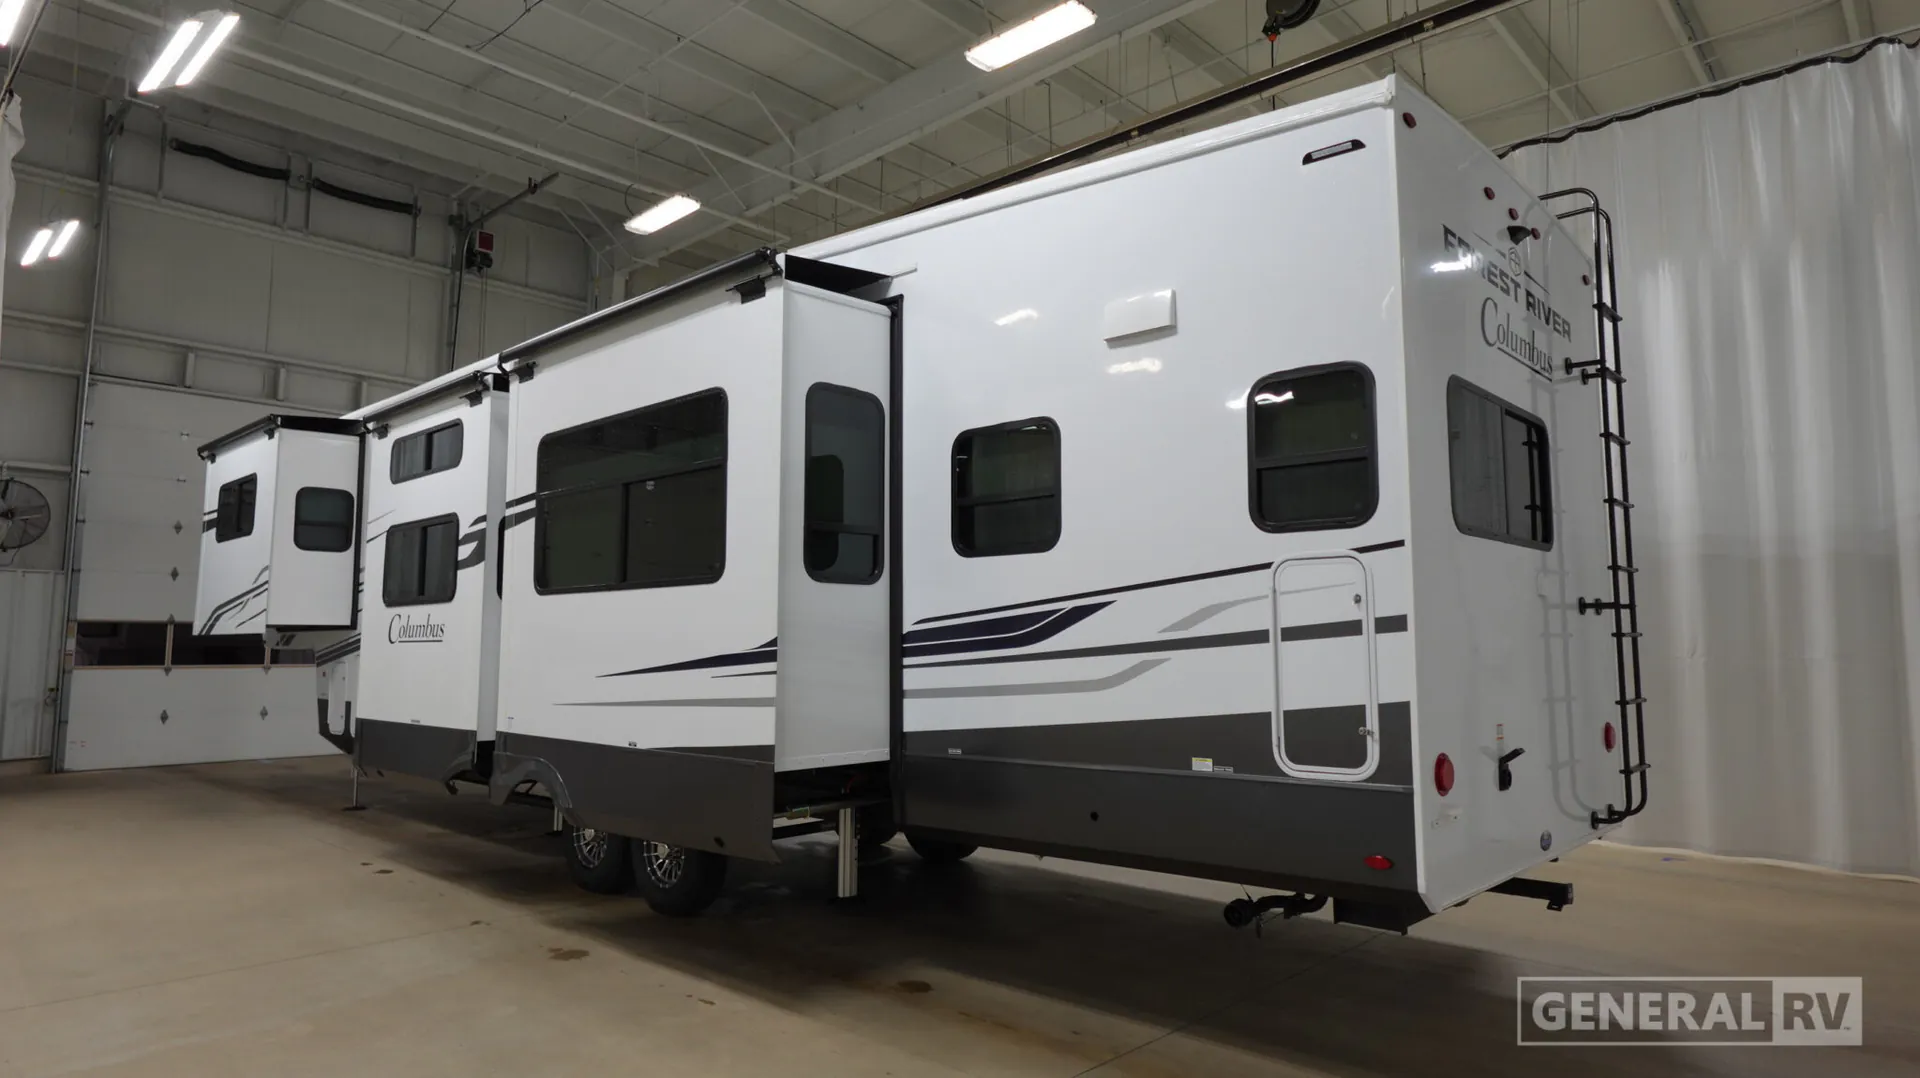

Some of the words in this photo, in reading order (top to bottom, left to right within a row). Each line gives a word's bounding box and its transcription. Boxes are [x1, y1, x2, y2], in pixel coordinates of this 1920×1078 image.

[1480, 297, 1553, 376] Columbus
[1525, 288, 1572, 343] RIVER
[388, 613, 446, 644] Columbus
